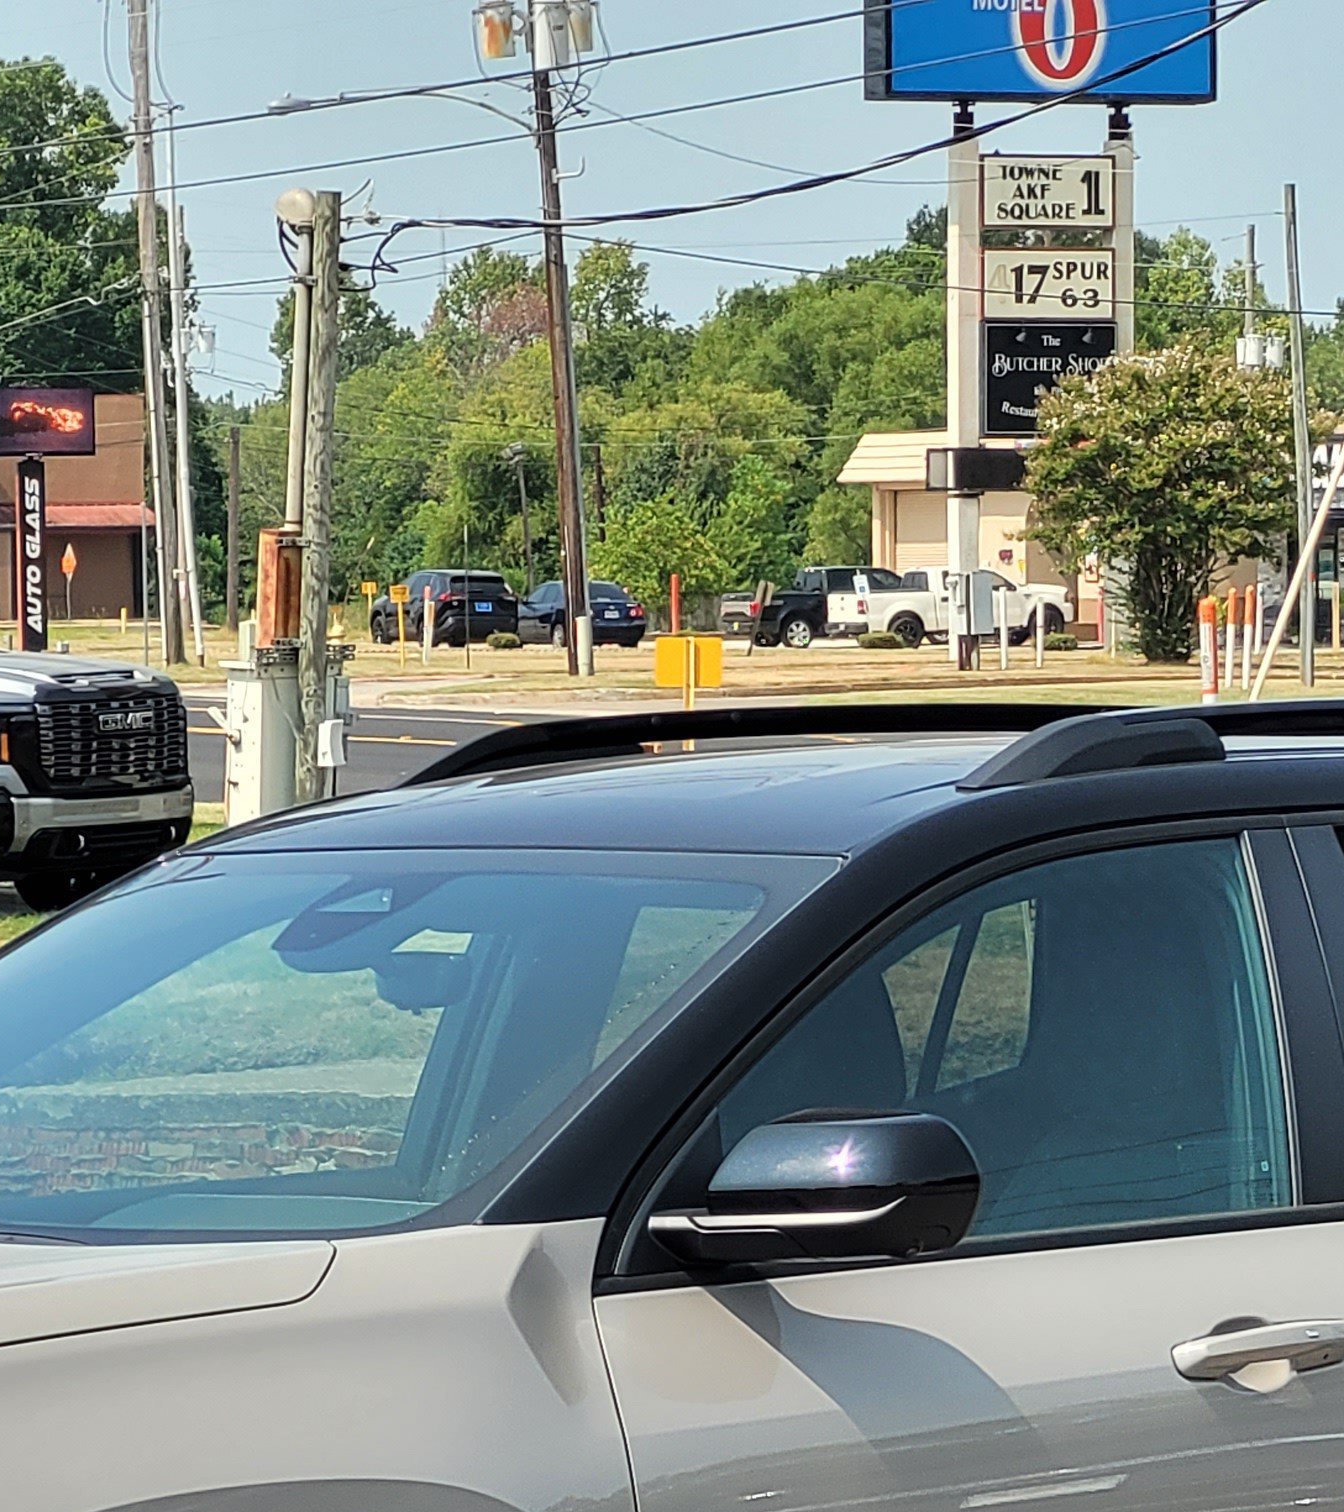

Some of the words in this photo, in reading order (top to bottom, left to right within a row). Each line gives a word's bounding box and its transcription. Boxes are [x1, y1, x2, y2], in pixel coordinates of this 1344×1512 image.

[997, 202, 1076, 220] SQUARE
[1053, 261, 1109, 280] SPUR
[1061, 288, 1100, 308] 63
[1041, 335, 1061, 346] The
[24, 476, 41, 559] GLASS
[25, 566, 43, 634] AUTO
[99, 711, 154, 731] GMC
